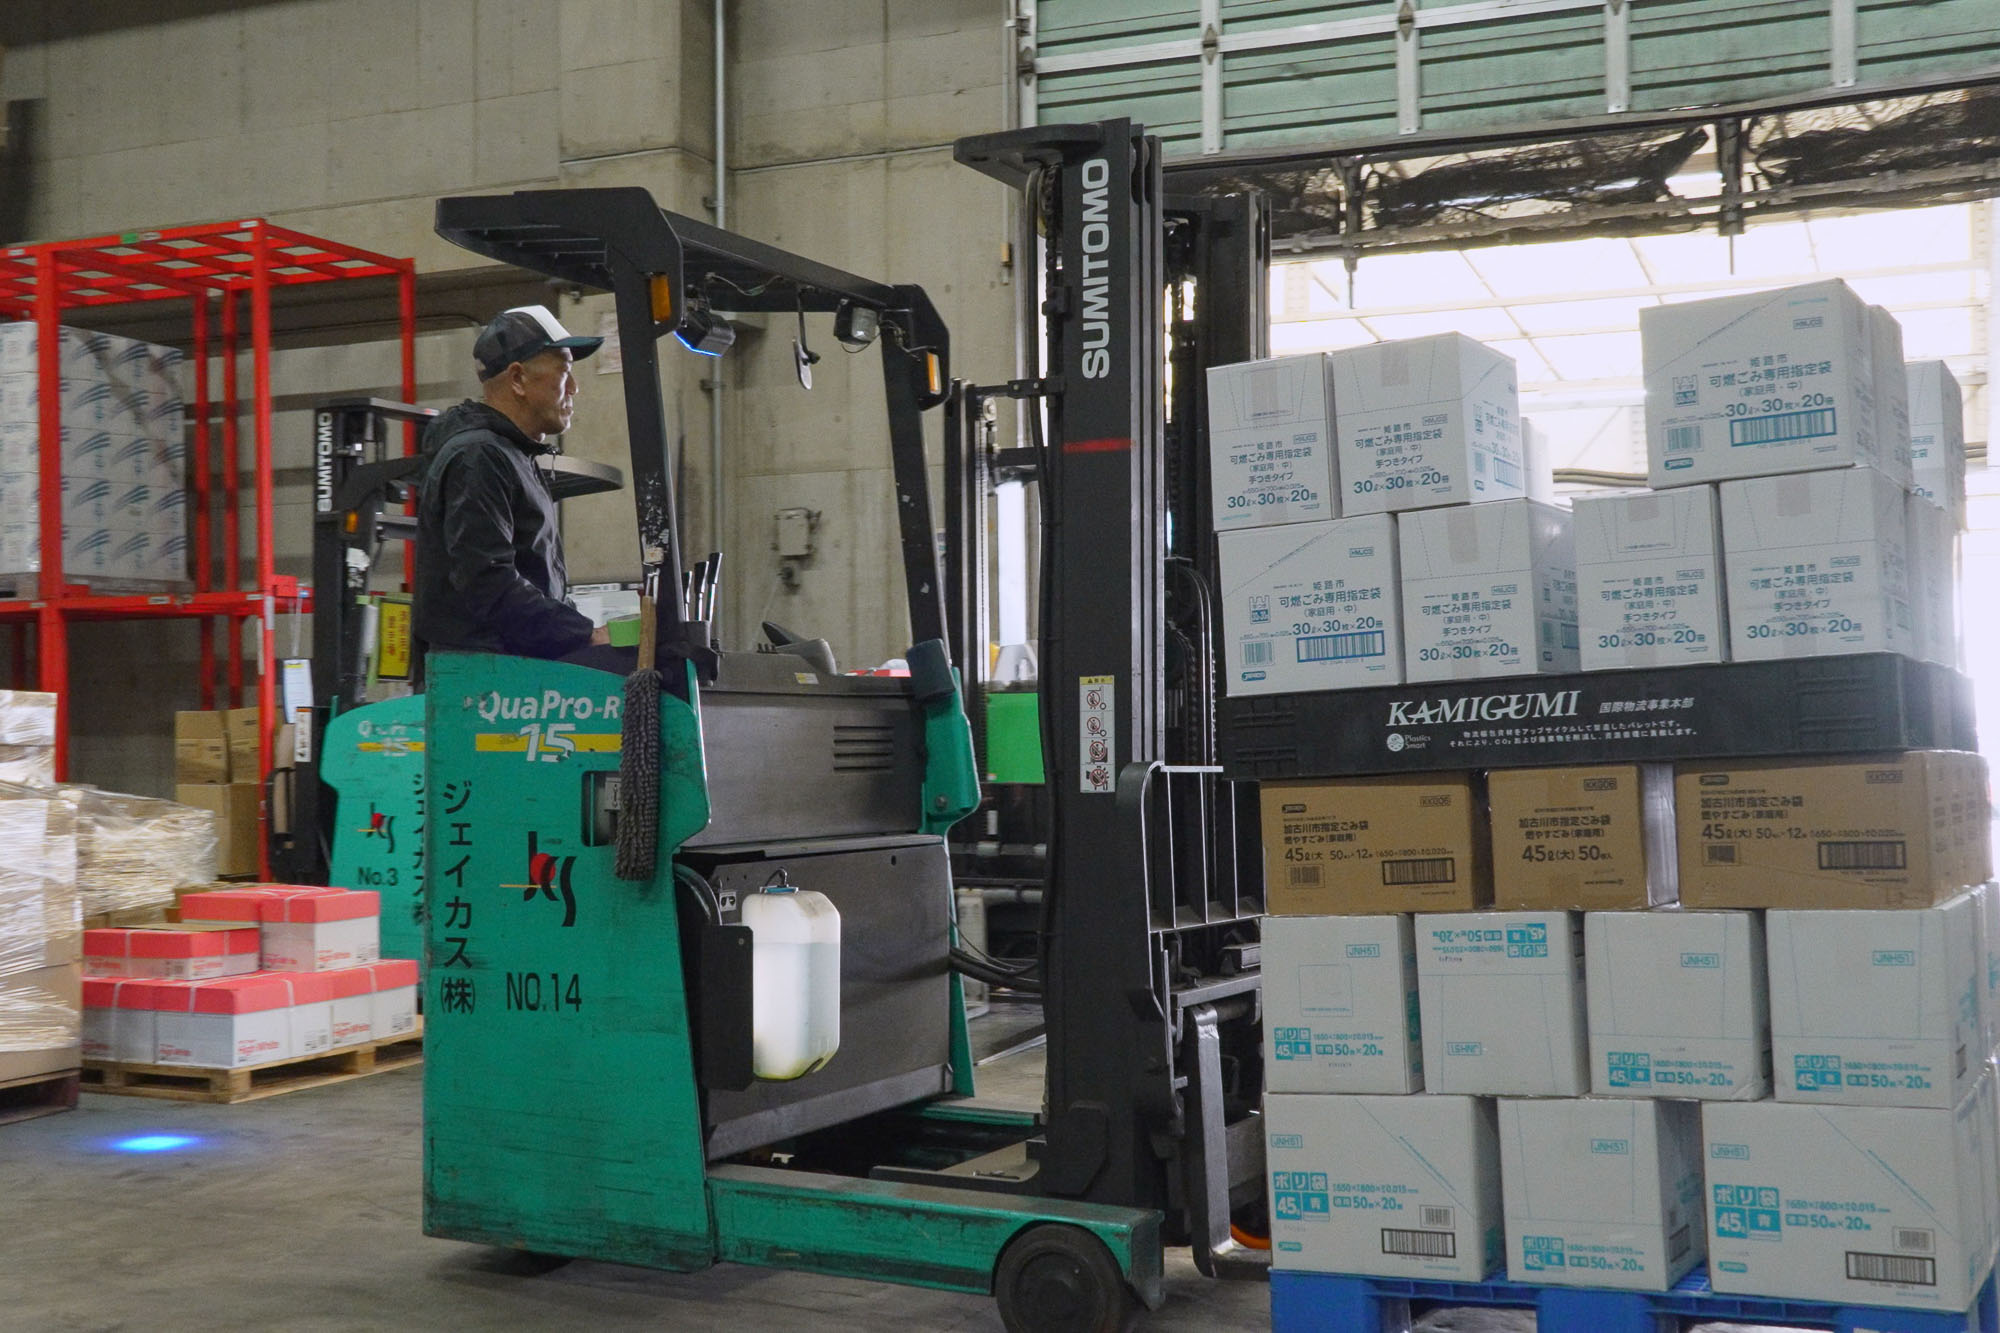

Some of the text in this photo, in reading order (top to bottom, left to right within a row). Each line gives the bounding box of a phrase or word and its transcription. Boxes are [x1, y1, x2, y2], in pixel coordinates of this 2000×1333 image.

[1082, 158, 1110, 379] SUMITOMO
[478, 690, 621, 724] QuaPro-R
[1385, 690, 1581, 727] KAMIGUMI
[520, 723, 576, 763] 15
[506, 972, 582, 1013] NO.14
